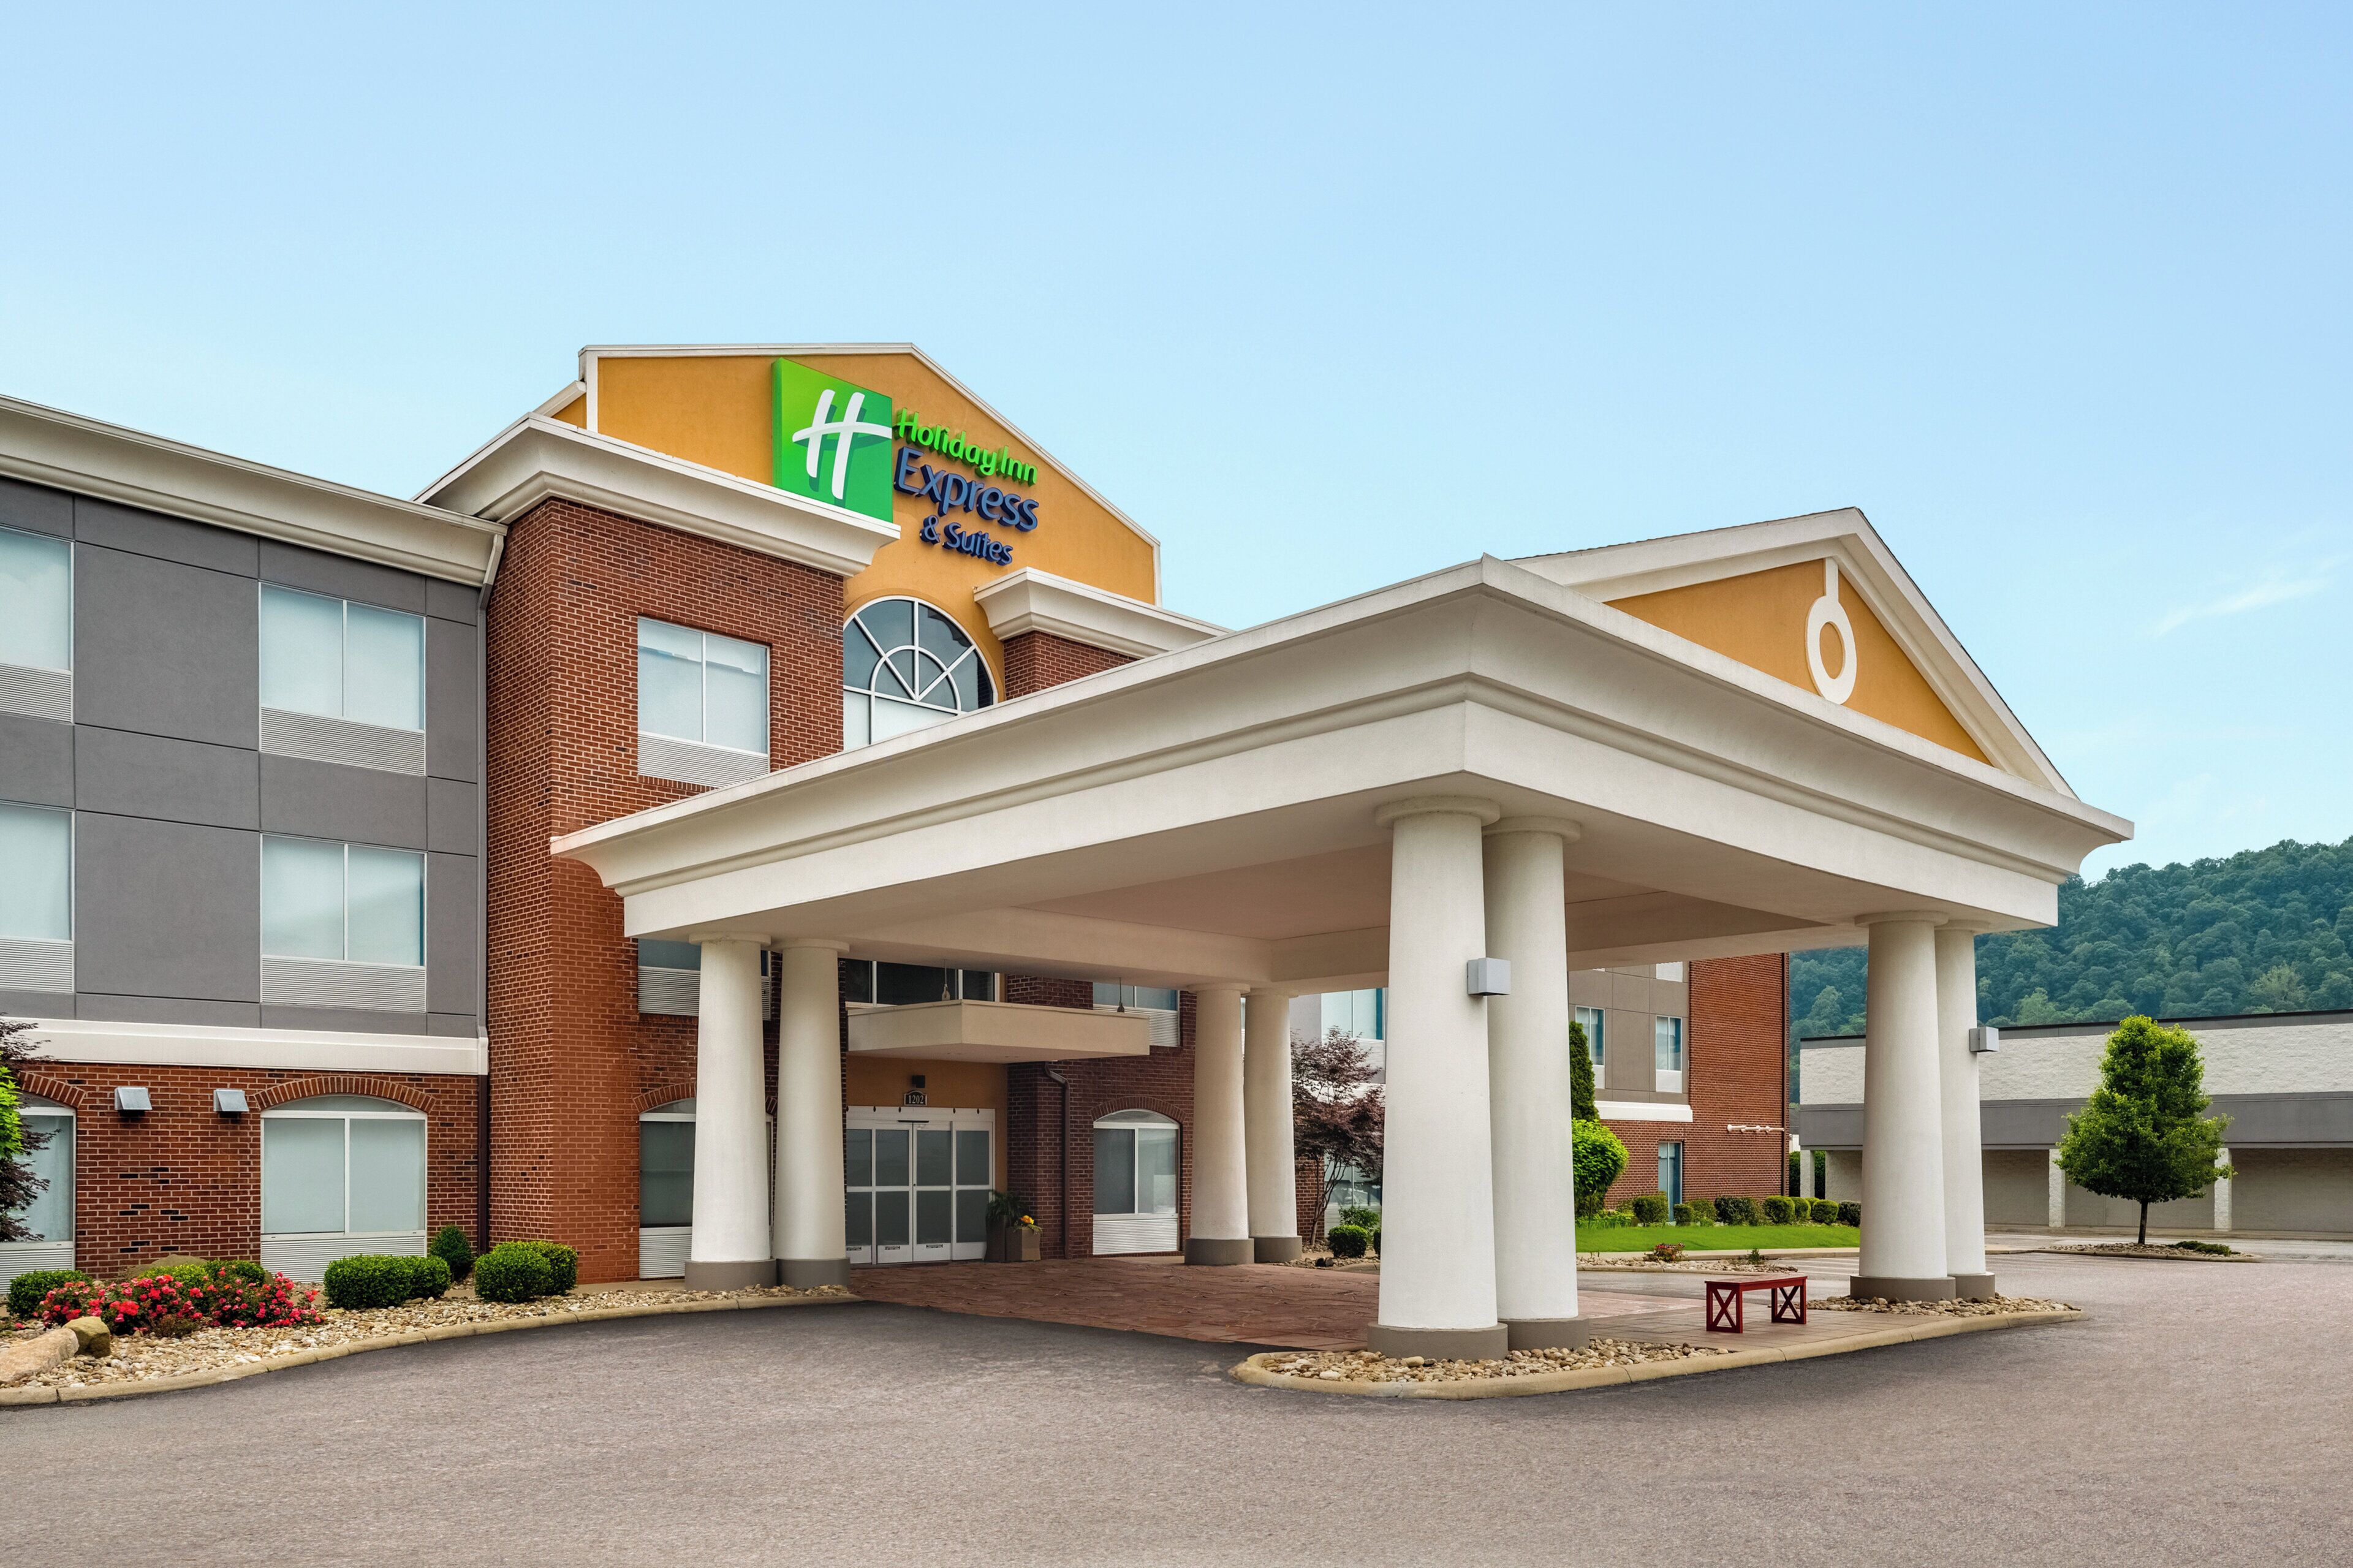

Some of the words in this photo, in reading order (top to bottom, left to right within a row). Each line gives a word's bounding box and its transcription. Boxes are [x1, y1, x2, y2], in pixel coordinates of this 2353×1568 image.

[894, 407, 998, 477] Holiday
[997, 445, 1038, 487] Inn
[894, 446, 1039, 532] Express
[920, 515, 940, 544] &
[942, 522, 1014, 566] Suites
[909, 1094, 924, 1104] 1202
